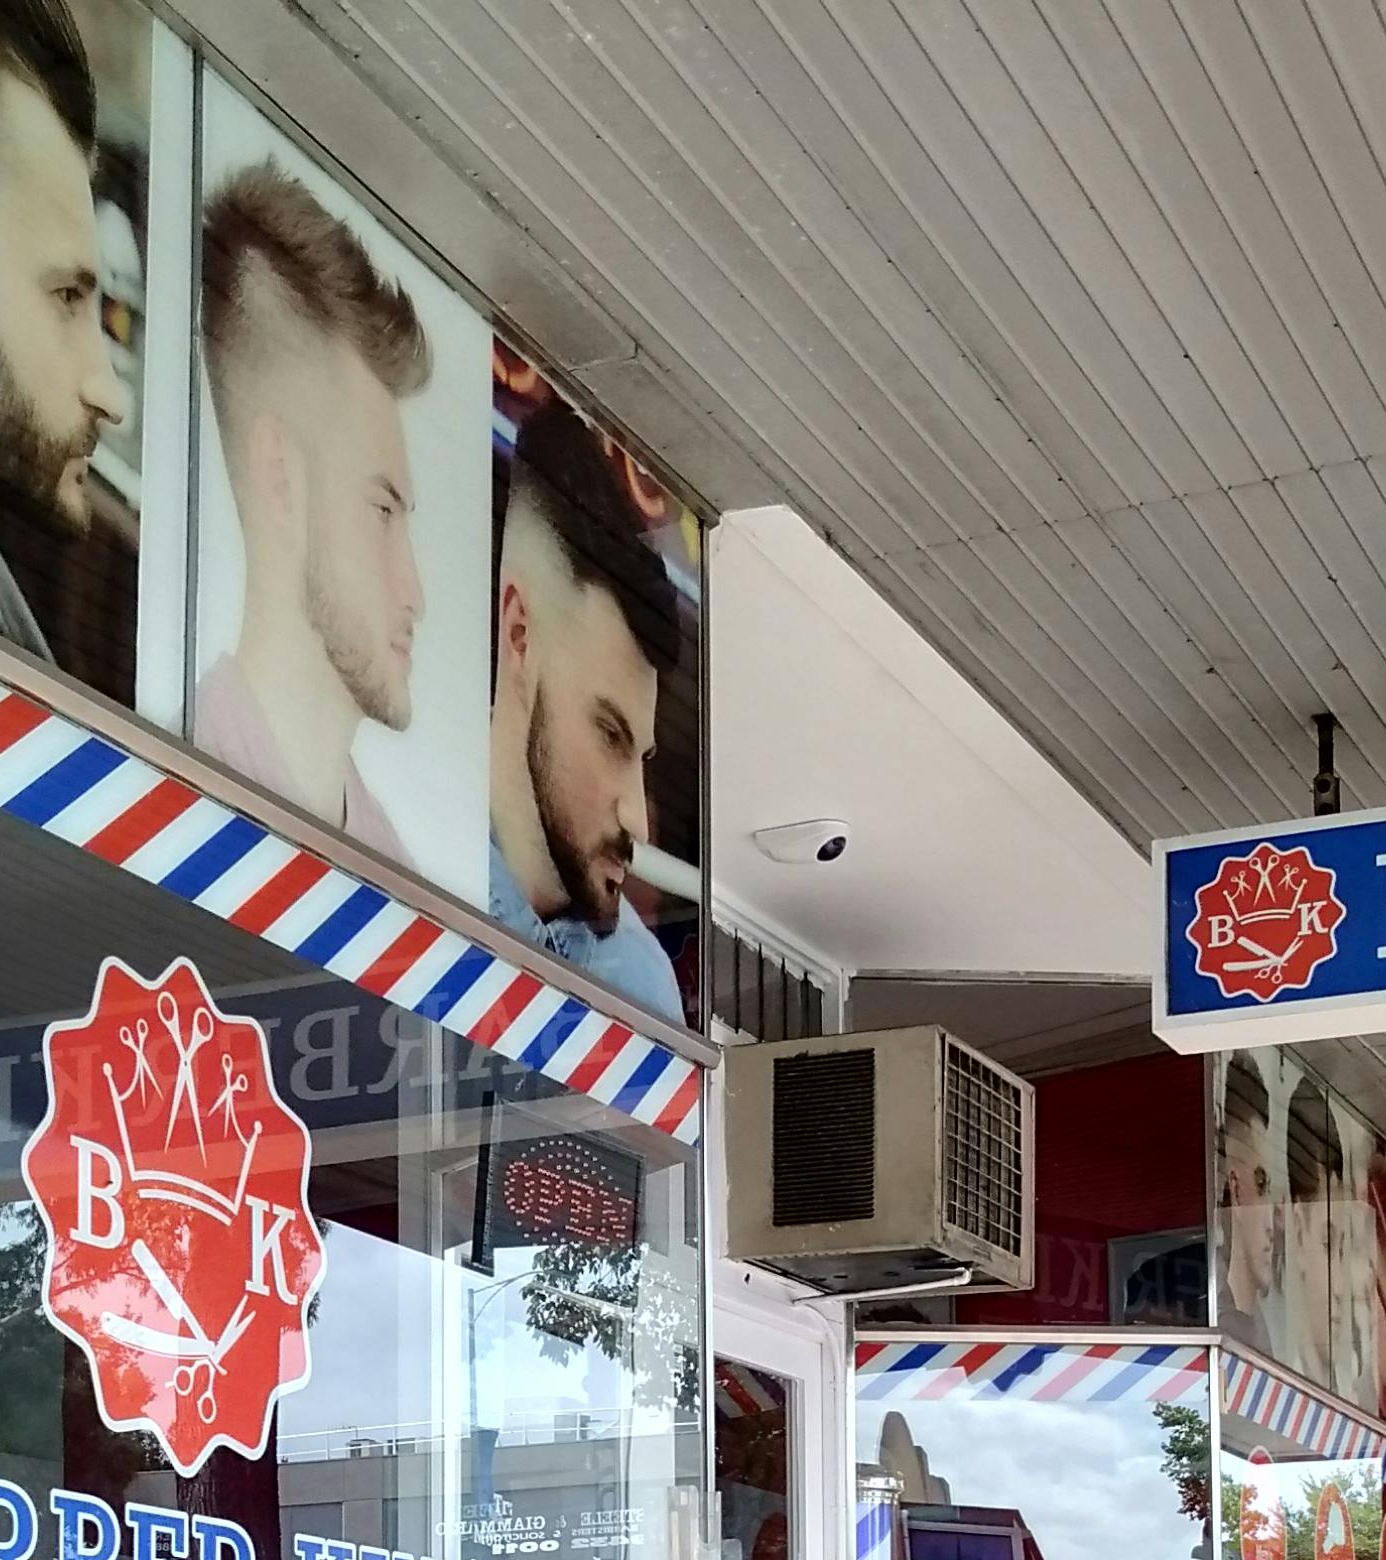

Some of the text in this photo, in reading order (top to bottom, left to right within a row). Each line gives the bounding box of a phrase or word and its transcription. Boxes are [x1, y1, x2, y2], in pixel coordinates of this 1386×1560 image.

[1208, 900, 1329, 948] B K
[68, 1134, 299, 1305] B K
[504, 1160, 633, 1246] OPEN
